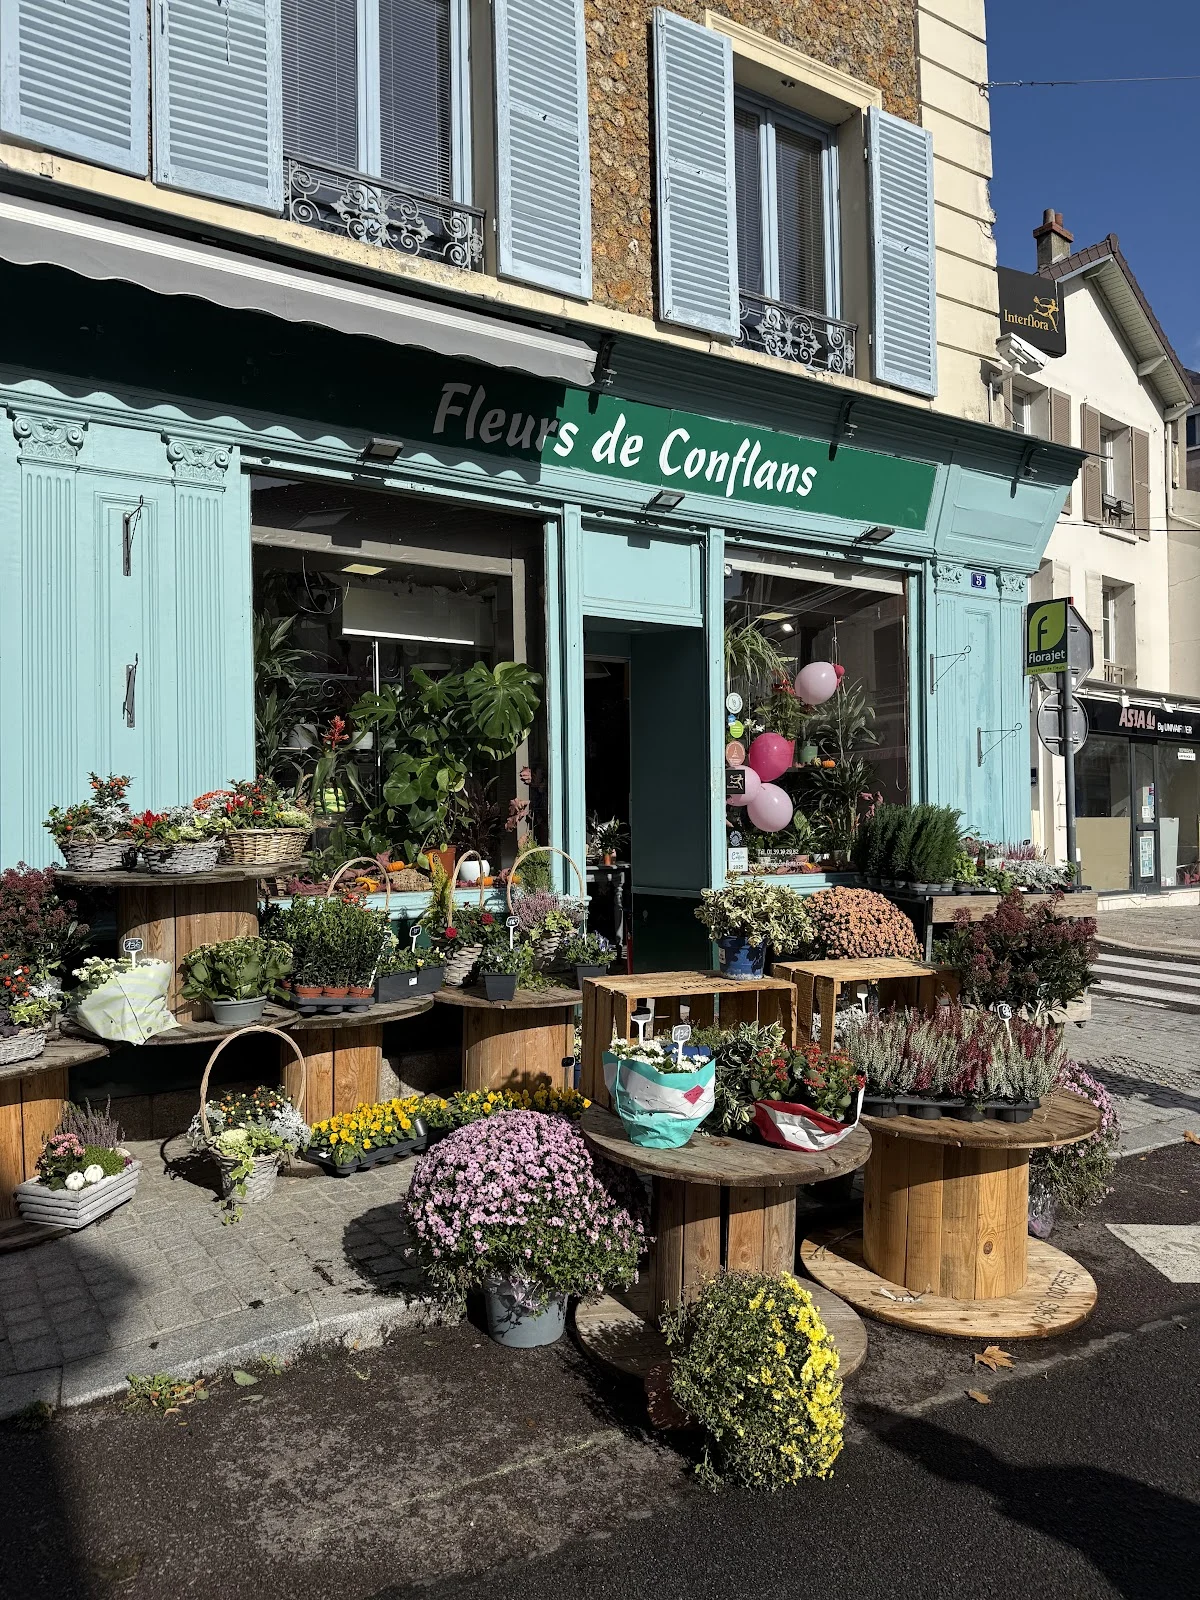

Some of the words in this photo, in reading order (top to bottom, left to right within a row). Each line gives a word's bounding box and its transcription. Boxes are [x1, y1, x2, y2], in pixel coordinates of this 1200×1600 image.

[1003, 309, 1049, 331] Interflora
[432, 382, 580, 458] Fleurs
[591, 413, 644, 468] de
[659, 427, 818, 498] Conflans
[975, 575, 982, 586] 5
[1028, 650, 1065, 664] florajet
[1118, 707, 1146, 729] ASIA
